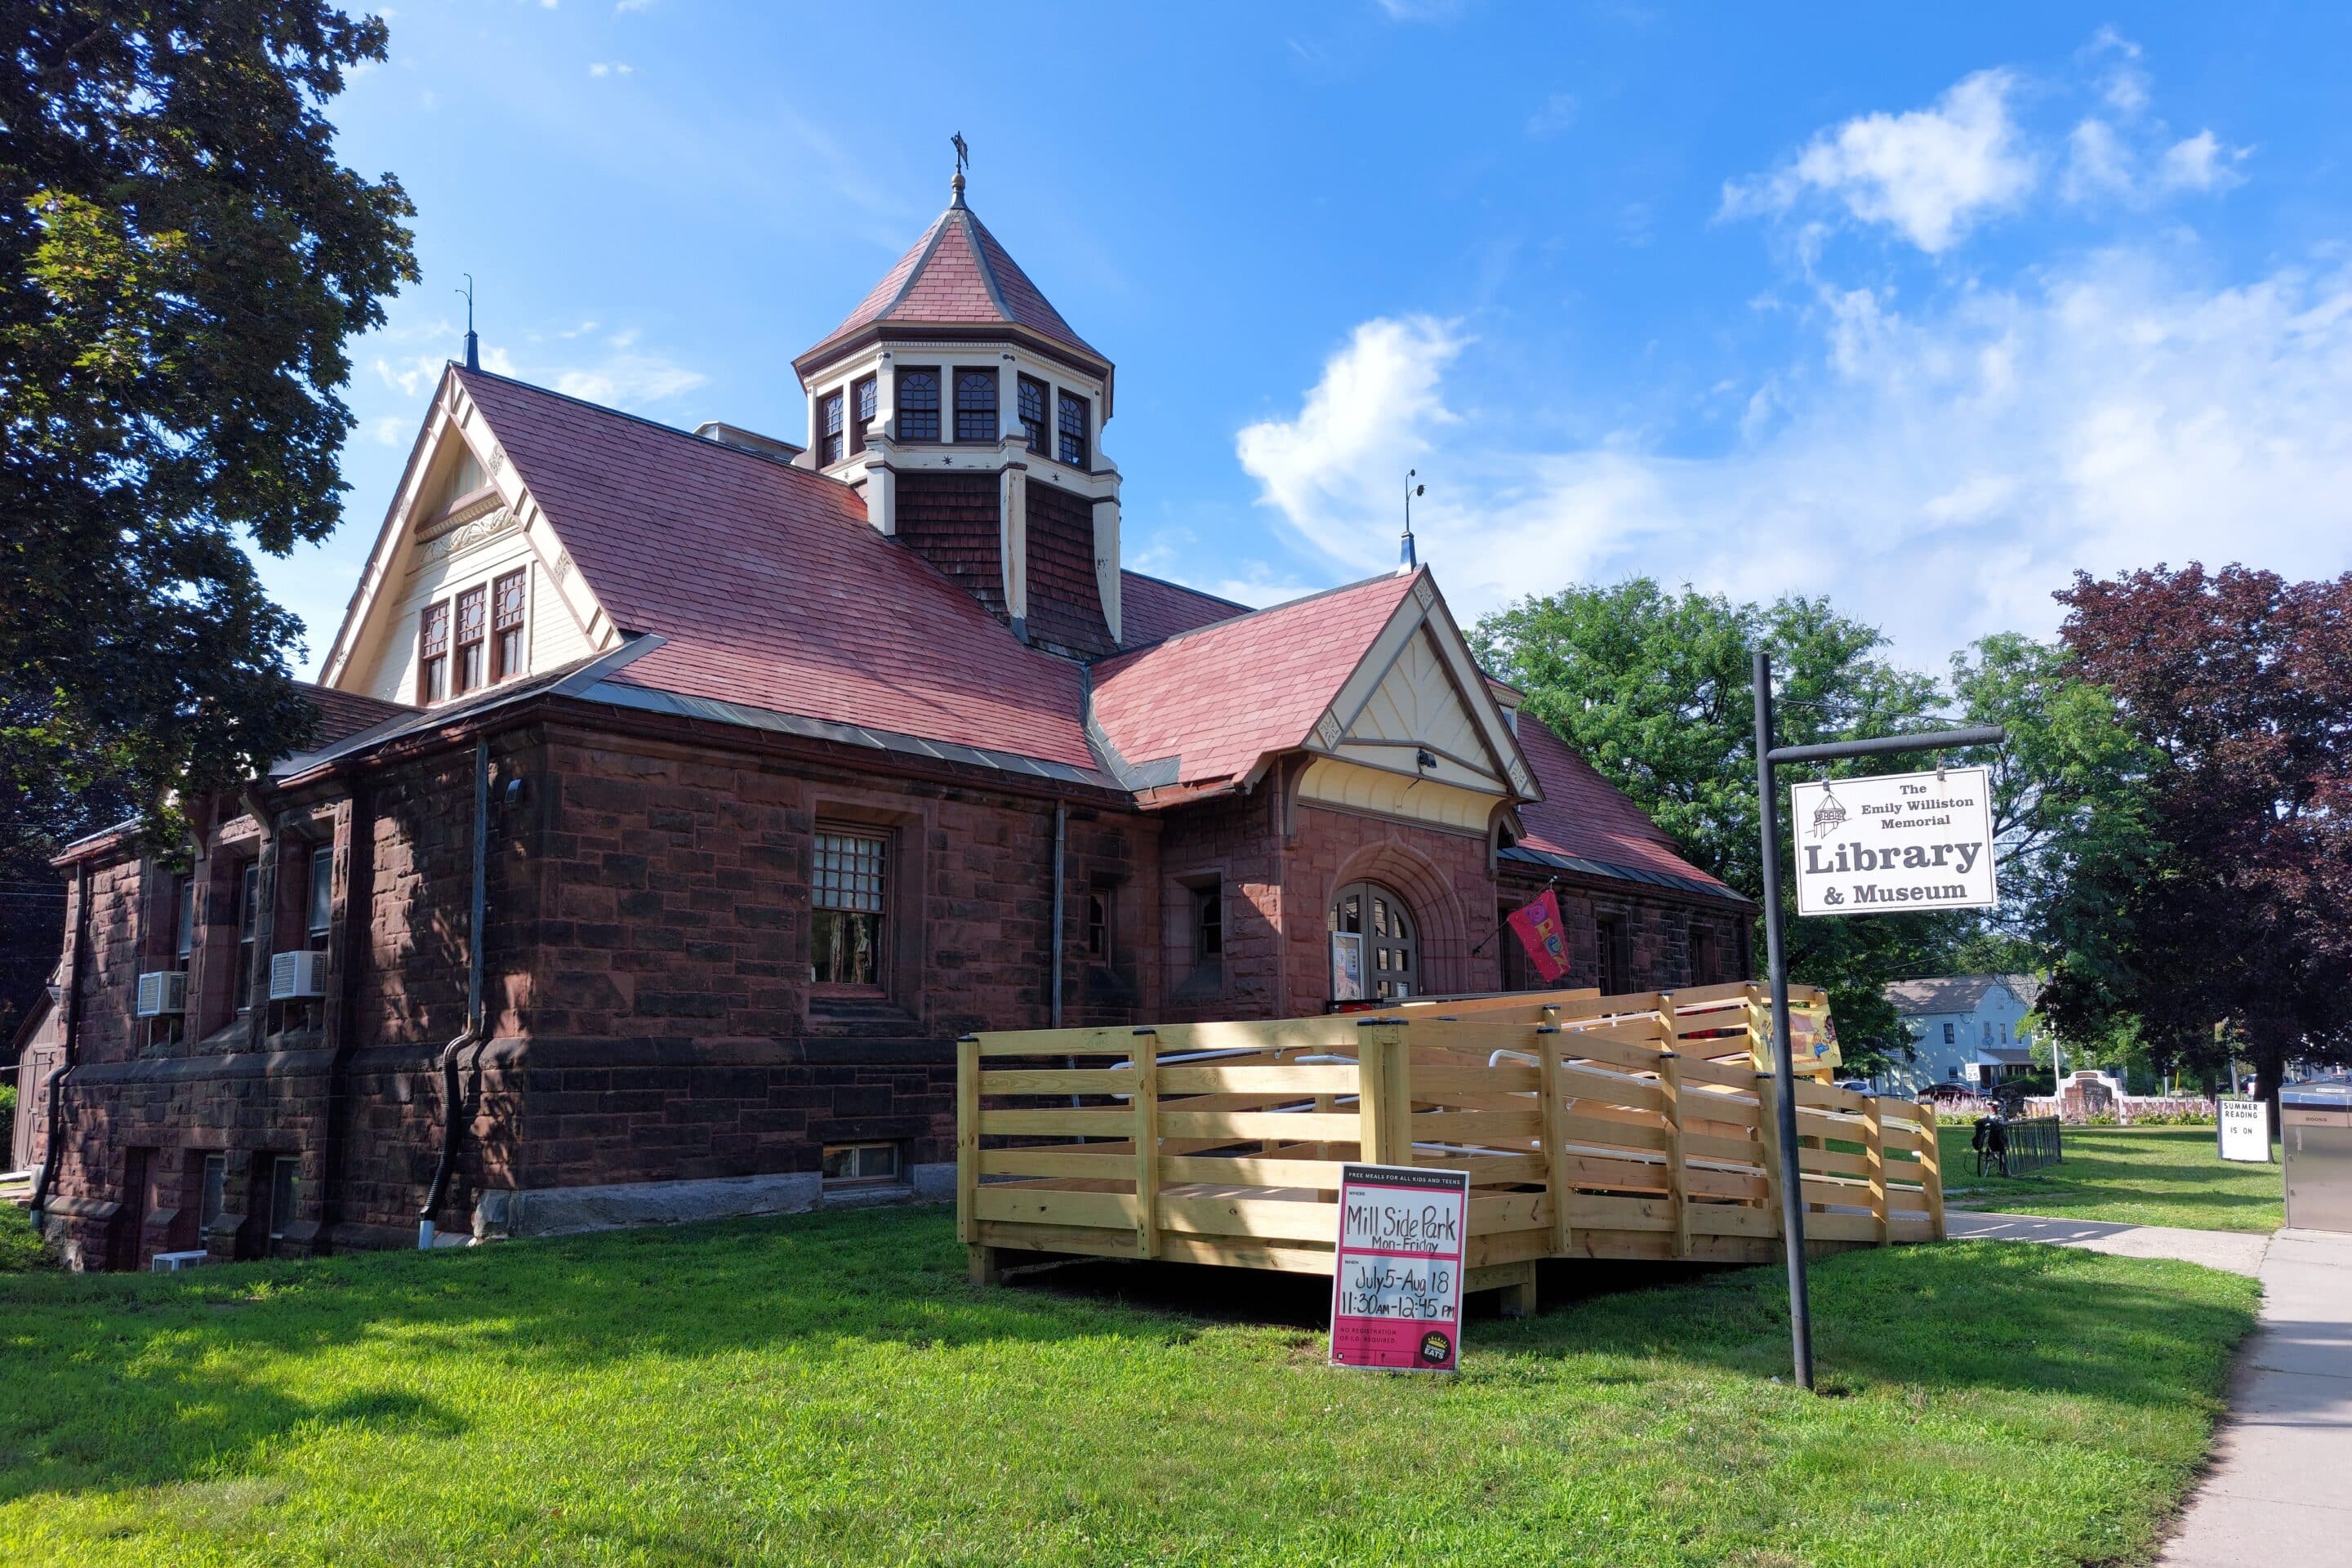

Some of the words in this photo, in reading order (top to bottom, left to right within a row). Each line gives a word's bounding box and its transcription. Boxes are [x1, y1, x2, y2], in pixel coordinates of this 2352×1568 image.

[1900, 784, 1927, 795] The
[1861, 803, 1902, 815] Emily
[1907, 798, 1975, 810] Williston
[1881, 815, 1951, 830] Memorial
[1804, 842, 1983, 874] Library
[1824, 886, 1845, 905] &
[1853, 884, 1967, 903] Museum
[2224, 1102, 2258, 1111] SUMMER
[2225, 1111, 2257, 1119] READING
[1347, 1205, 1379, 1236] Mill
[1383, 1206, 1419, 1238] Side
[1422, 1205, 1456, 1241] Park
[1356, 1266, 1384, 1295] July
[1432, 1271, 1450, 1294] 18
[1423, 1348, 1445, 1360] EATS
